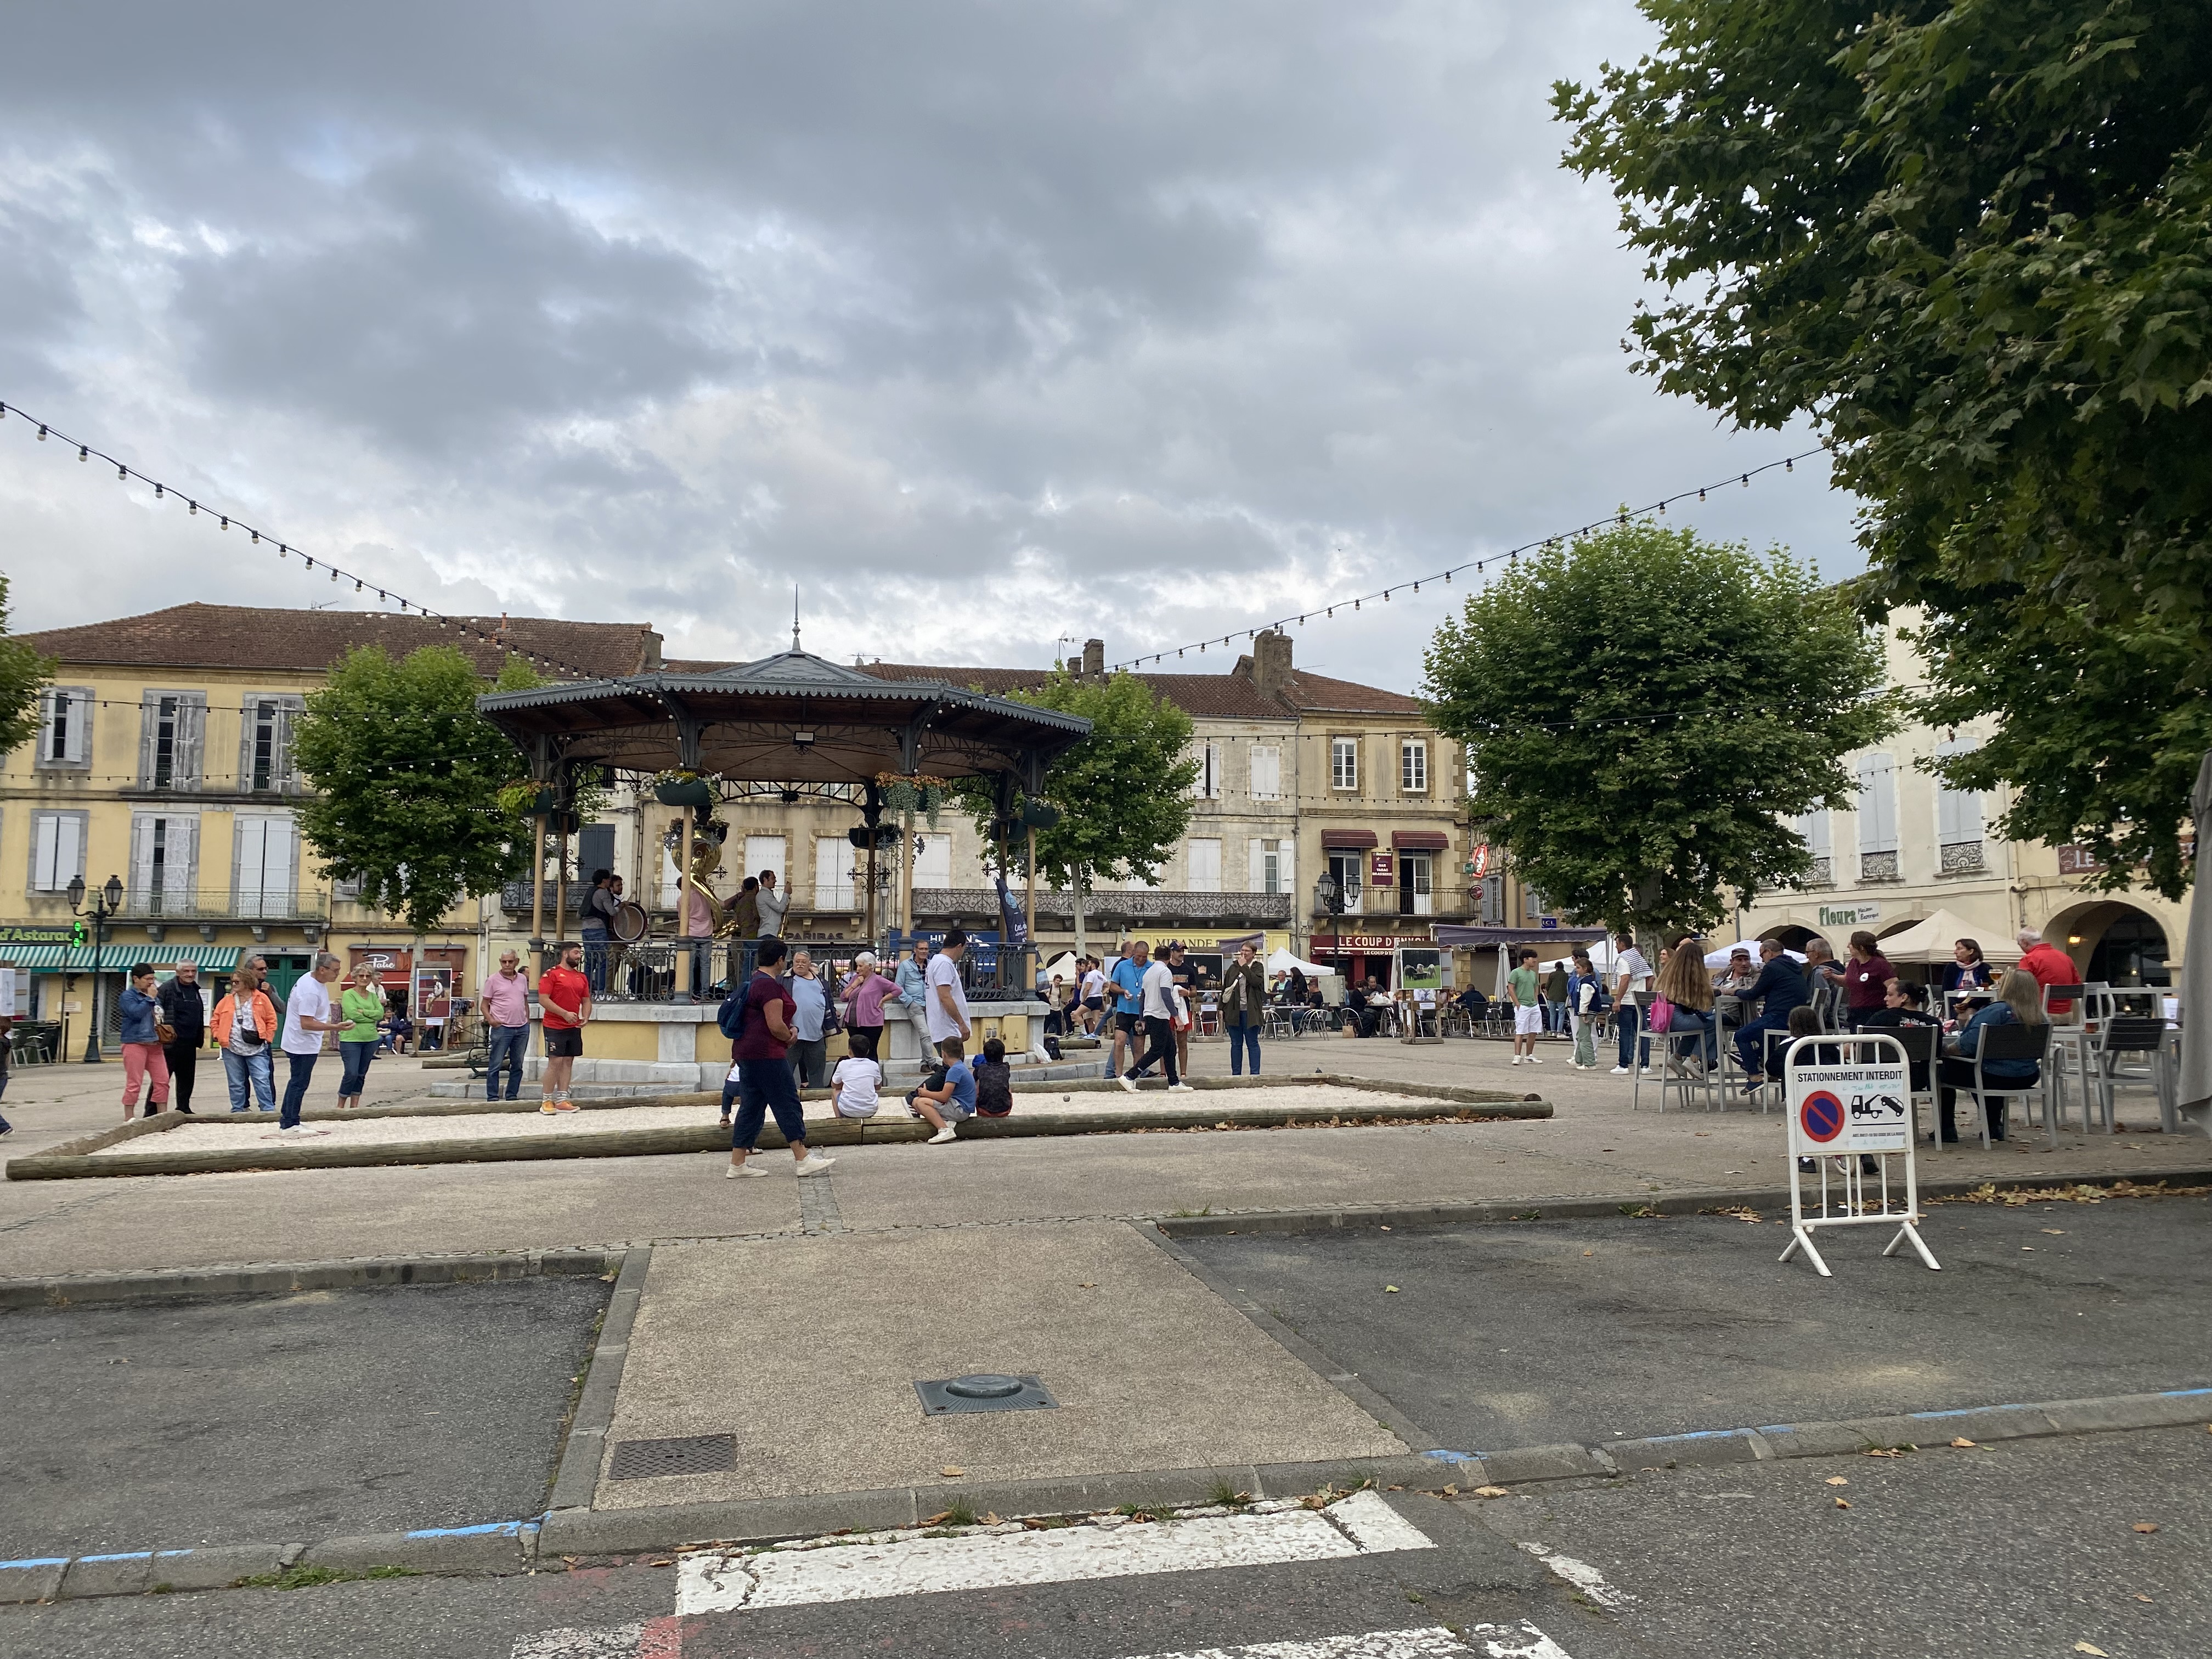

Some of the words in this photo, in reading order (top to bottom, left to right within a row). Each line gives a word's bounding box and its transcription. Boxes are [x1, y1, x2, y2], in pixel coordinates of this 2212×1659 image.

[1476, 848, 1485, 874] TABAC
[2075, 850, 2095, 868] LE
[1819, 906, 1857, 926] fleurs
[930, 934, 973, 943] HUN
[1339, 937, 1352, 946] LE
[1355, 937, 1383, 946] COUP
[1798, 1072, 1864, 1082] STATIONNEMENT
[1866, 1071, 1903, 1080] INTERDIT
